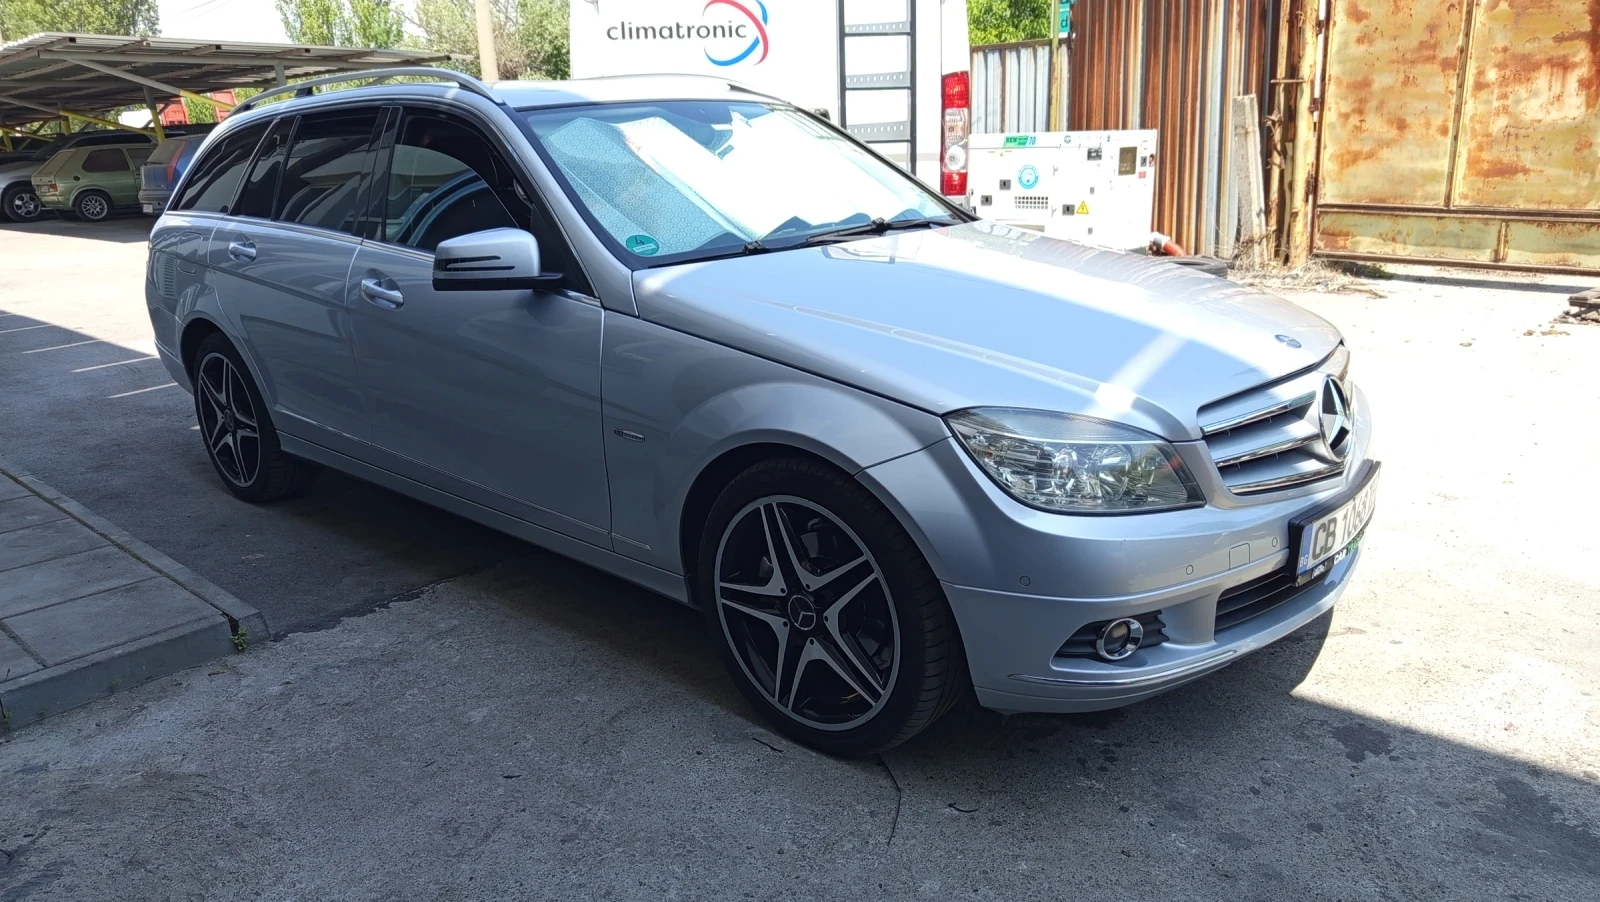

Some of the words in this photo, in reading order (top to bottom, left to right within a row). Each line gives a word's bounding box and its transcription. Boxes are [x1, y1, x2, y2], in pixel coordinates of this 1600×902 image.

[606, 20, 747, 41] climatronic
[1312, 517, 1337, 560] CB
[1299, 554, 1309, 568] BG
